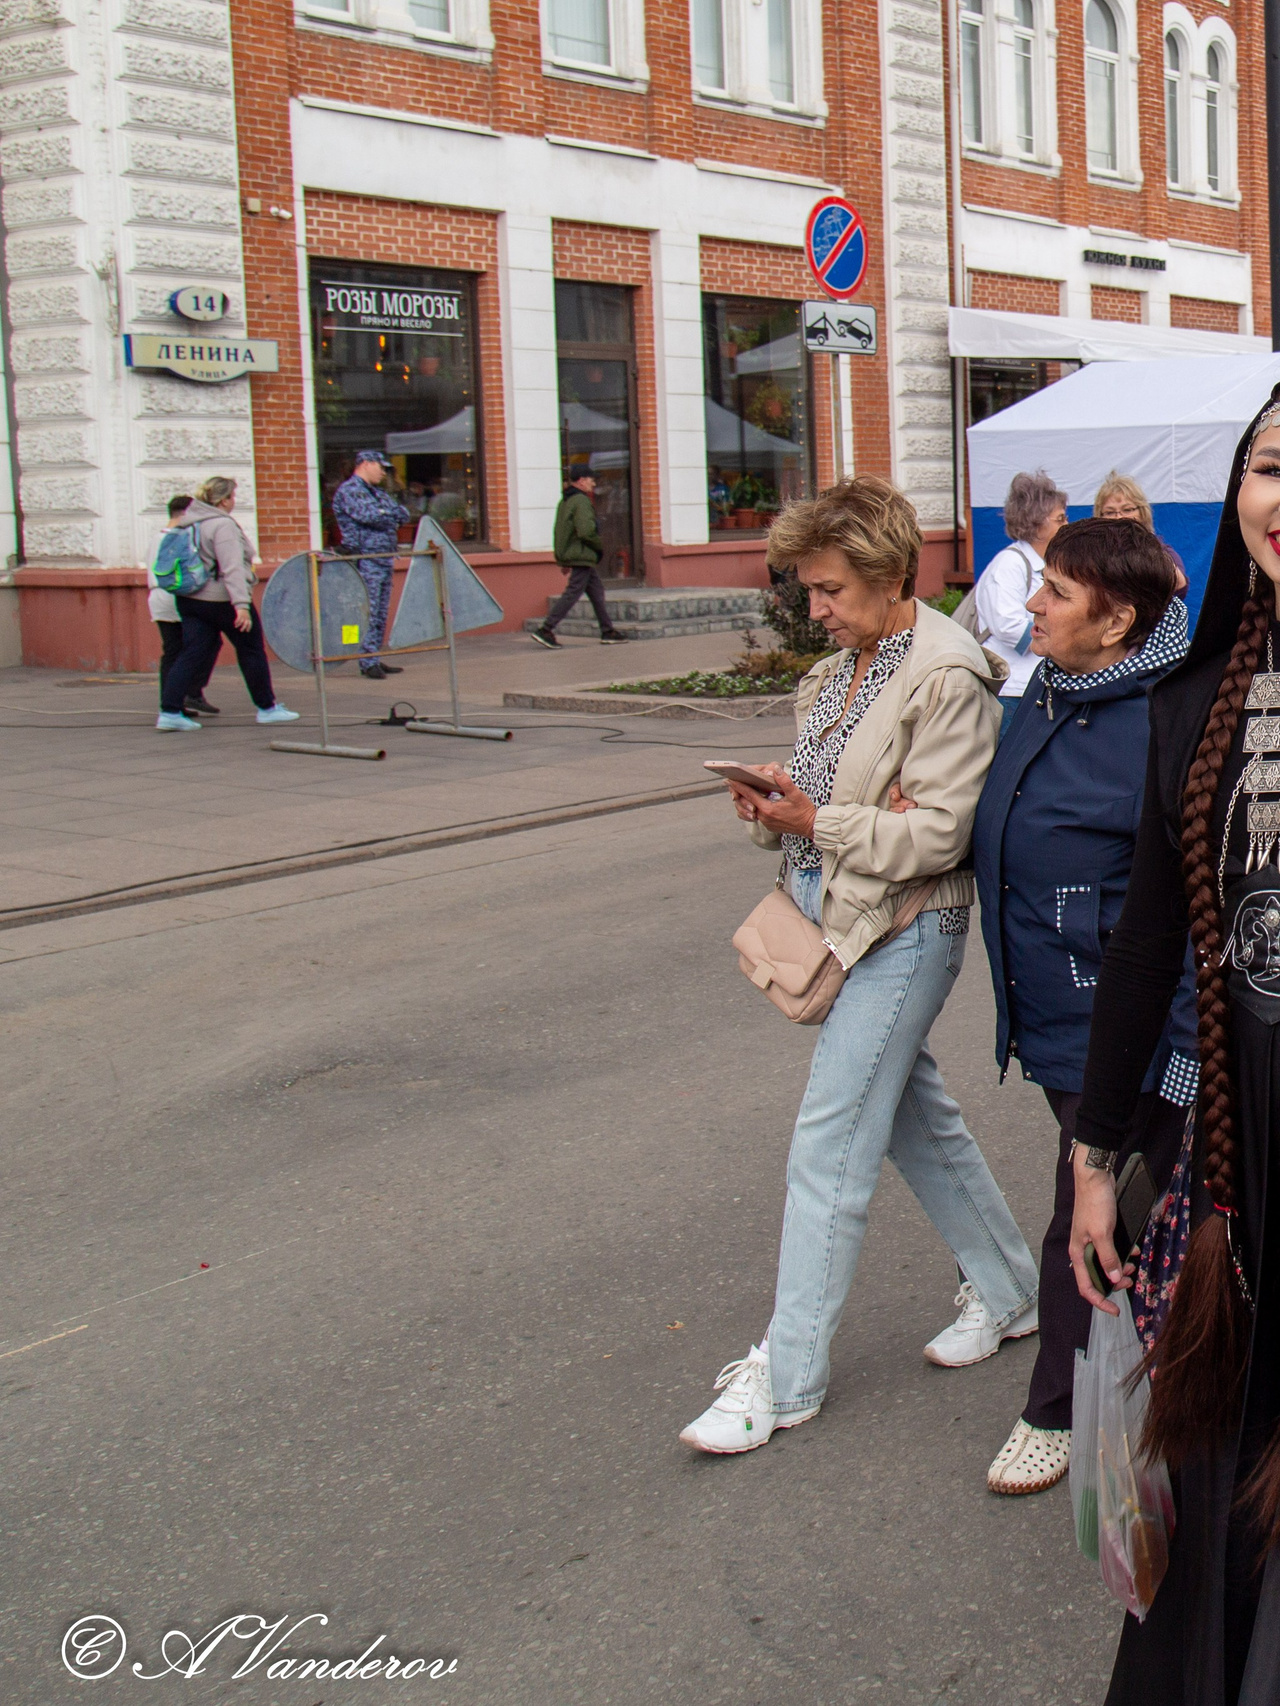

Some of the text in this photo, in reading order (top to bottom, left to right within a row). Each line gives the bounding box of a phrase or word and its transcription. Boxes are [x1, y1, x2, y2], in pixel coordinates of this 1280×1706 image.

[192, 295, 216, 312] 14
[325, 288, 460, 320] РОЗЫ МОРОЗЫ
[360, 316, 433, 329] ПРЯНО И ВЕСЕЛО
[157, 344, 256, 363] ЛЕНИНА
[190, 368, 229, 379] УЛИЦА
